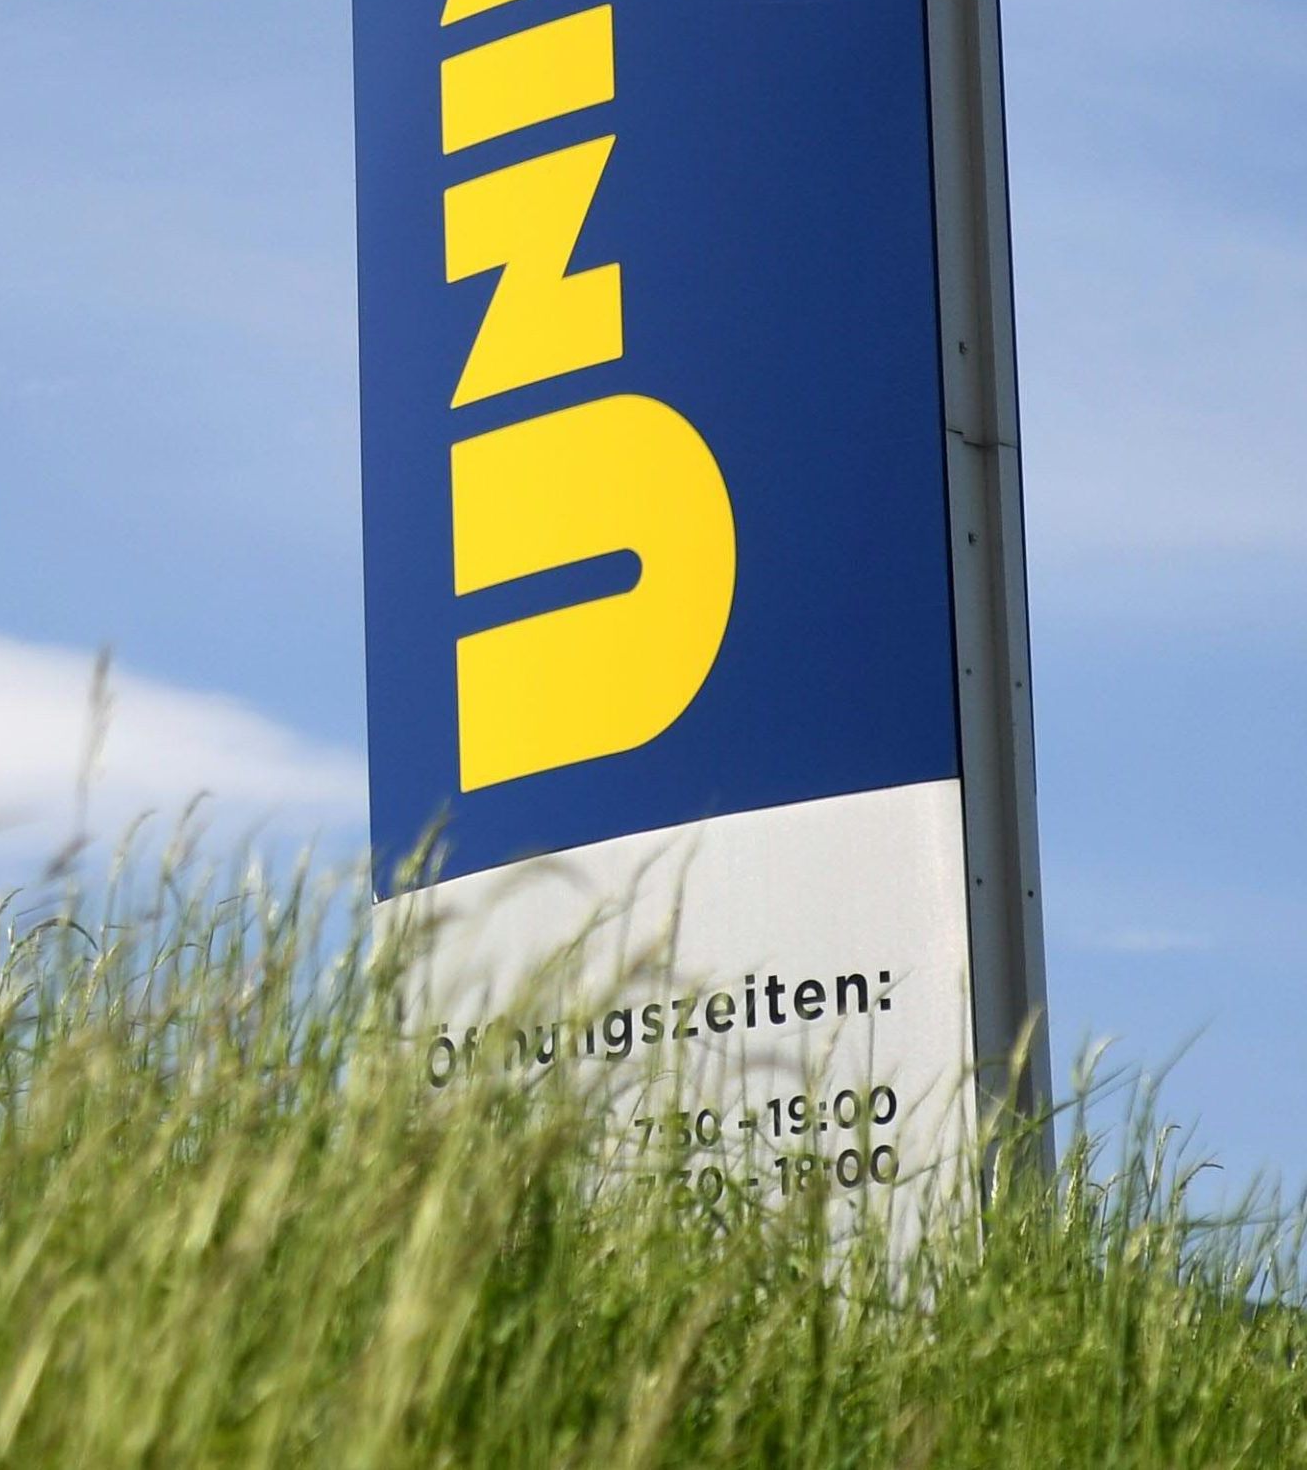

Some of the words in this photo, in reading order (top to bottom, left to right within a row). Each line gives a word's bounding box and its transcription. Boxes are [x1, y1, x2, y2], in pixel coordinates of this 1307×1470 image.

[427, 971, 891, 1088] Öfnungszeiten:
[766, 1084, 897, 1137] 19:00
[636, 1166, 723, 1210] 30
